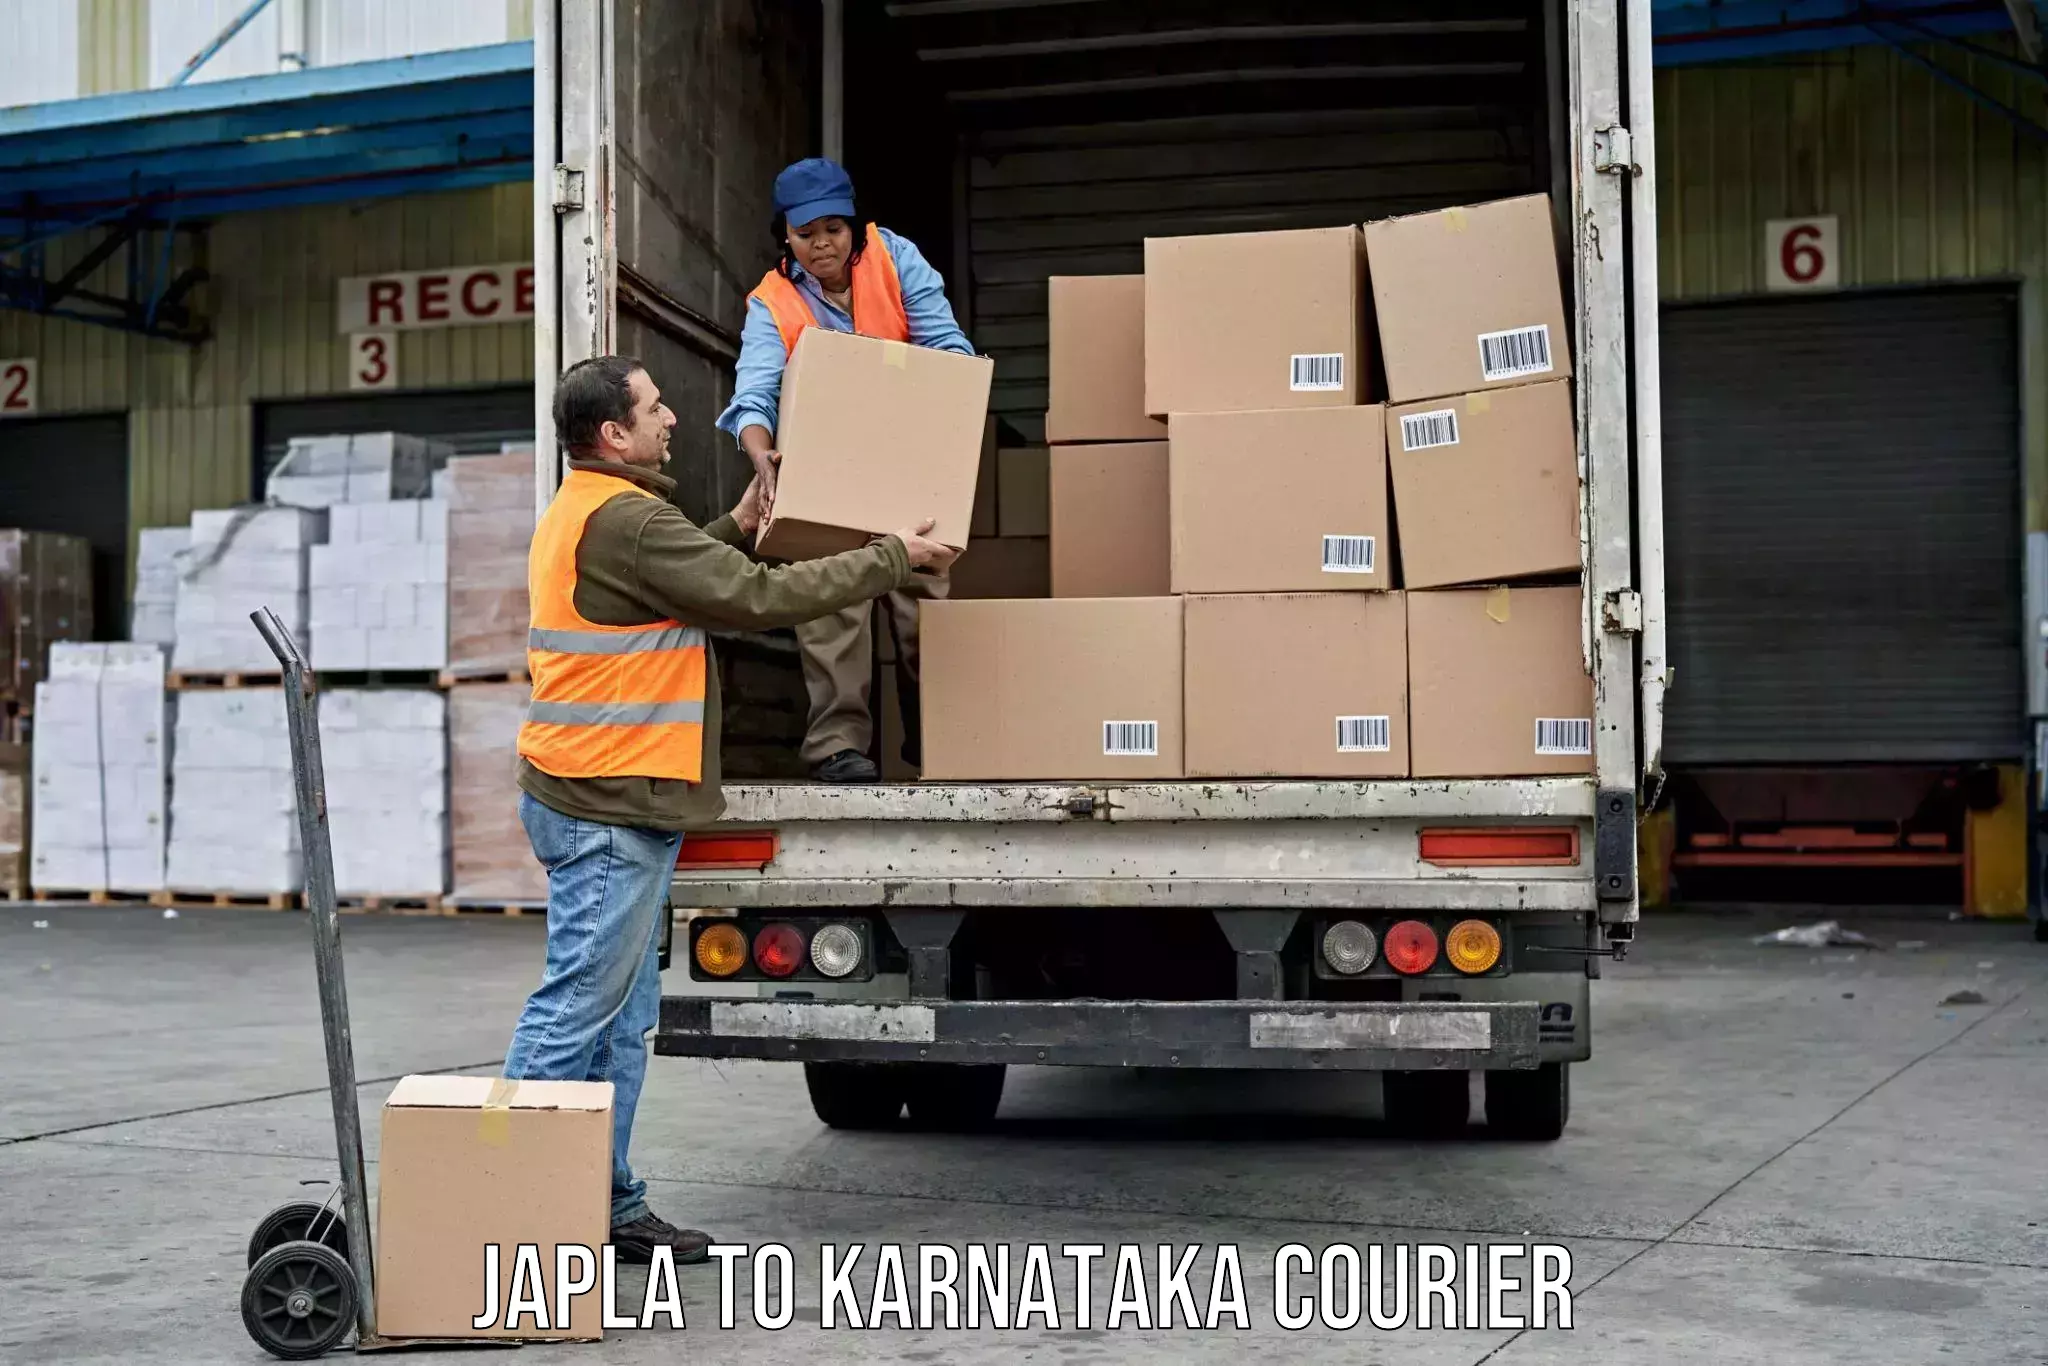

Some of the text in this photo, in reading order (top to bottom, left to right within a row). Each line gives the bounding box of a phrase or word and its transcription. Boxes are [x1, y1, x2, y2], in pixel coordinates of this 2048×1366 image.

[1780, 223, 1825, 284] 6
[359, 336, 388, 386] 3
[3, 365, 29, 409] 2
